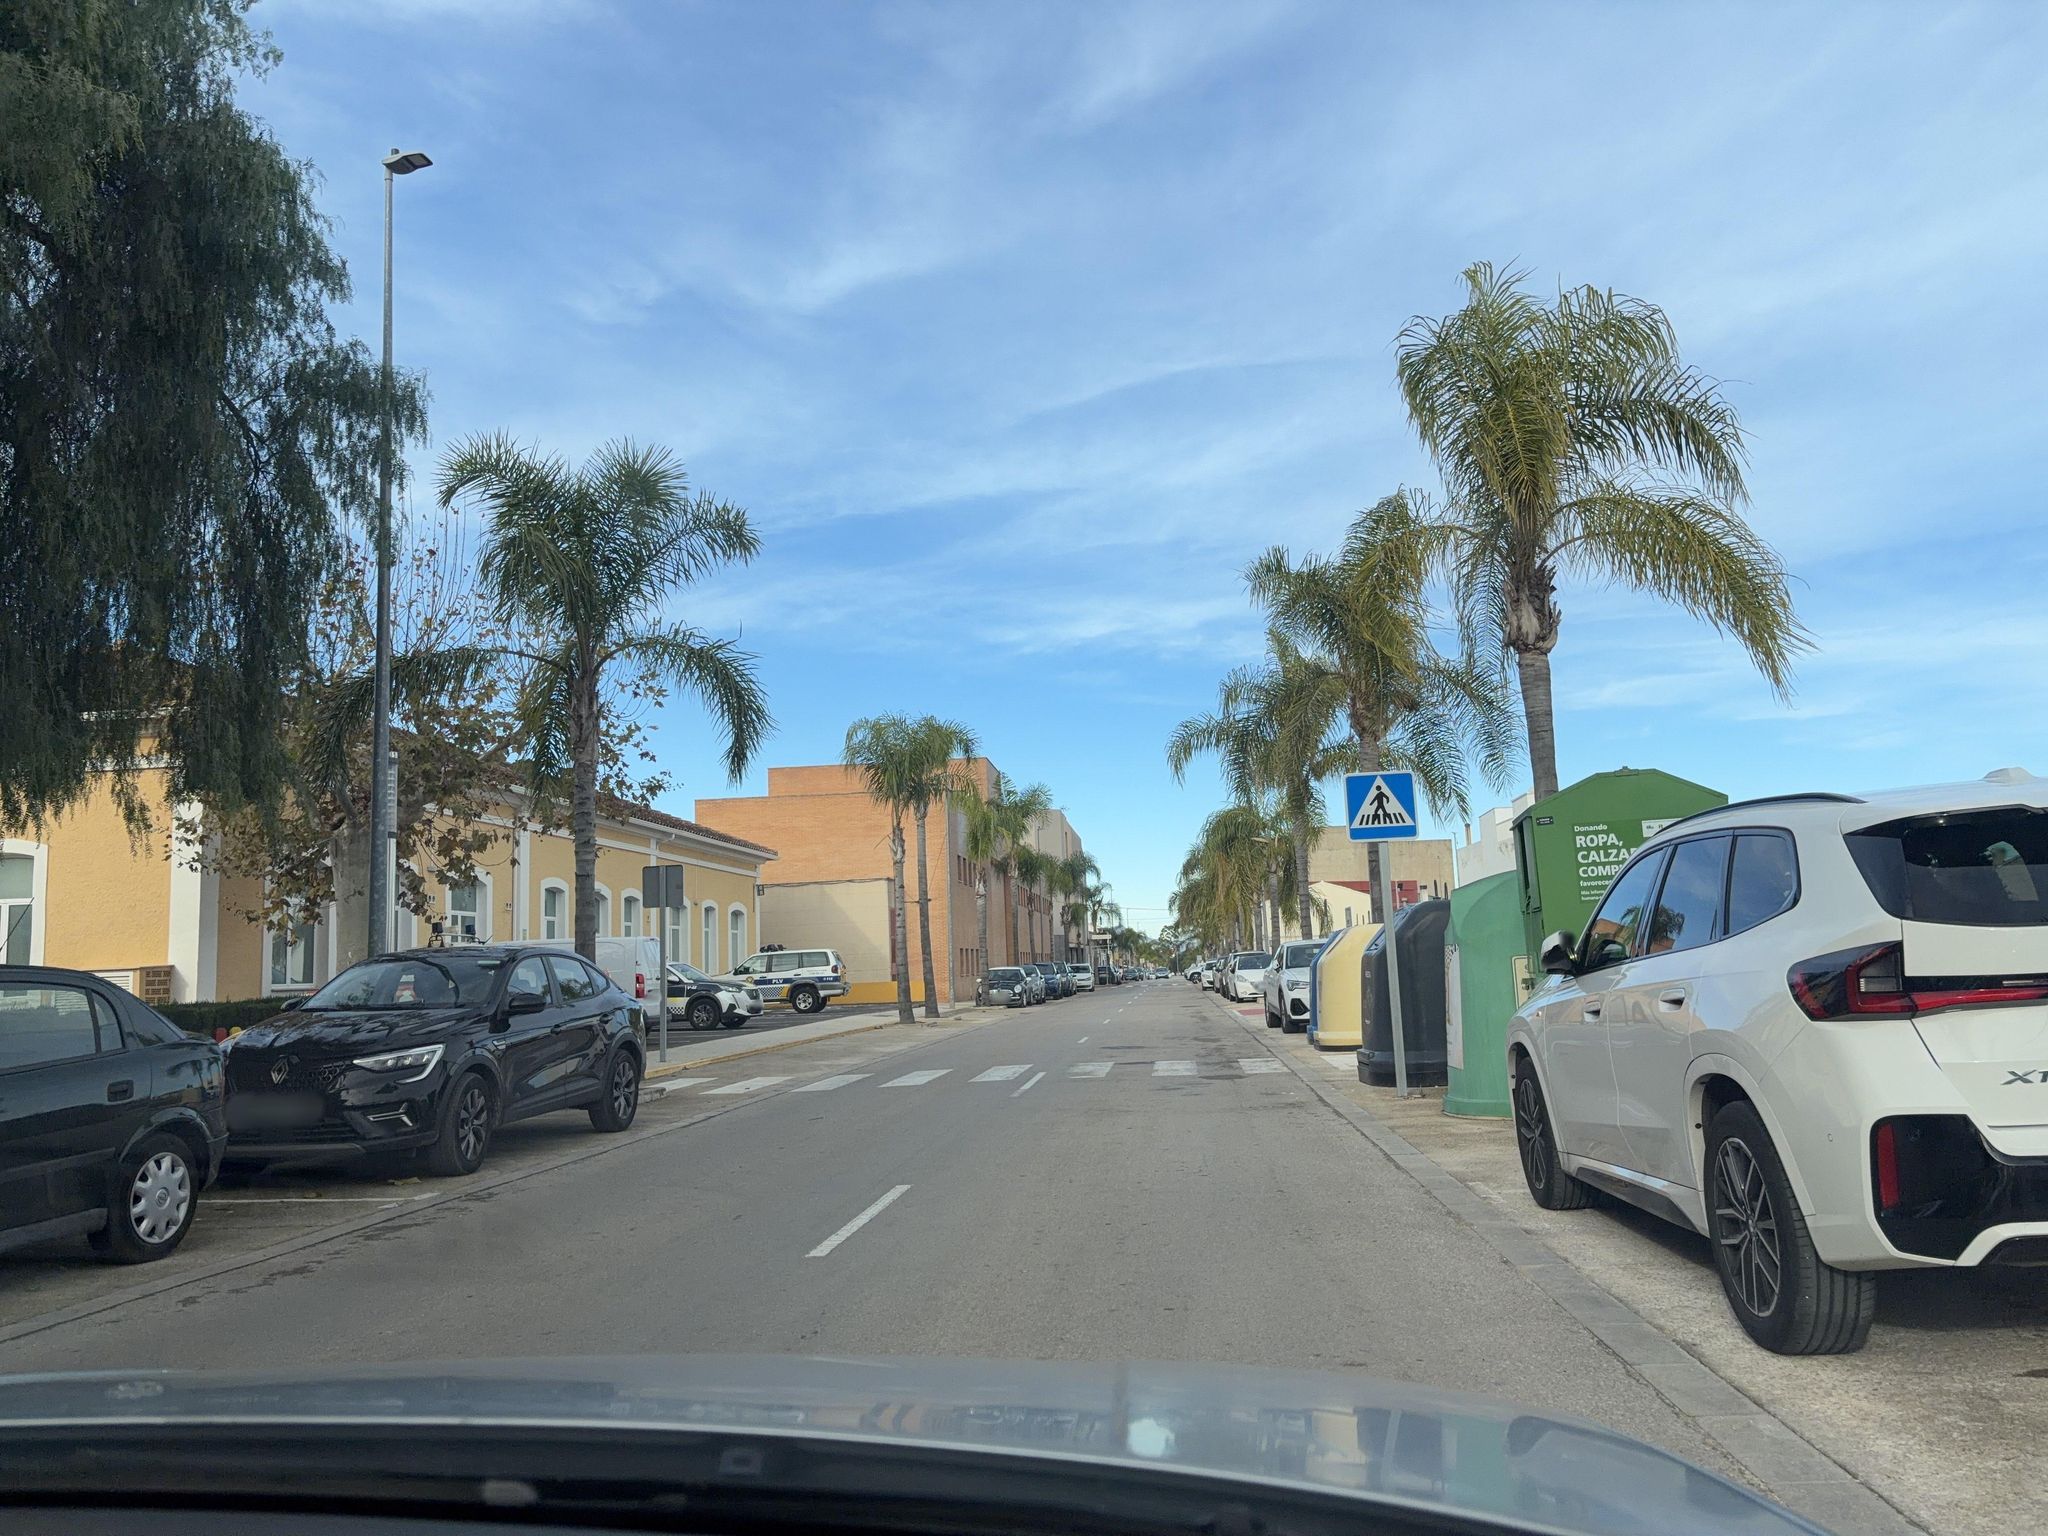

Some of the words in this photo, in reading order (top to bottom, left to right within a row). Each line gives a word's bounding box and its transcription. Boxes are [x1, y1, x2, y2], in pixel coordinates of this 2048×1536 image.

[1574, 824, 1608, 832] Donando
[1575, 833, 1623, 848] ROPA,
[1579, 864, 1622, 877] COMP
